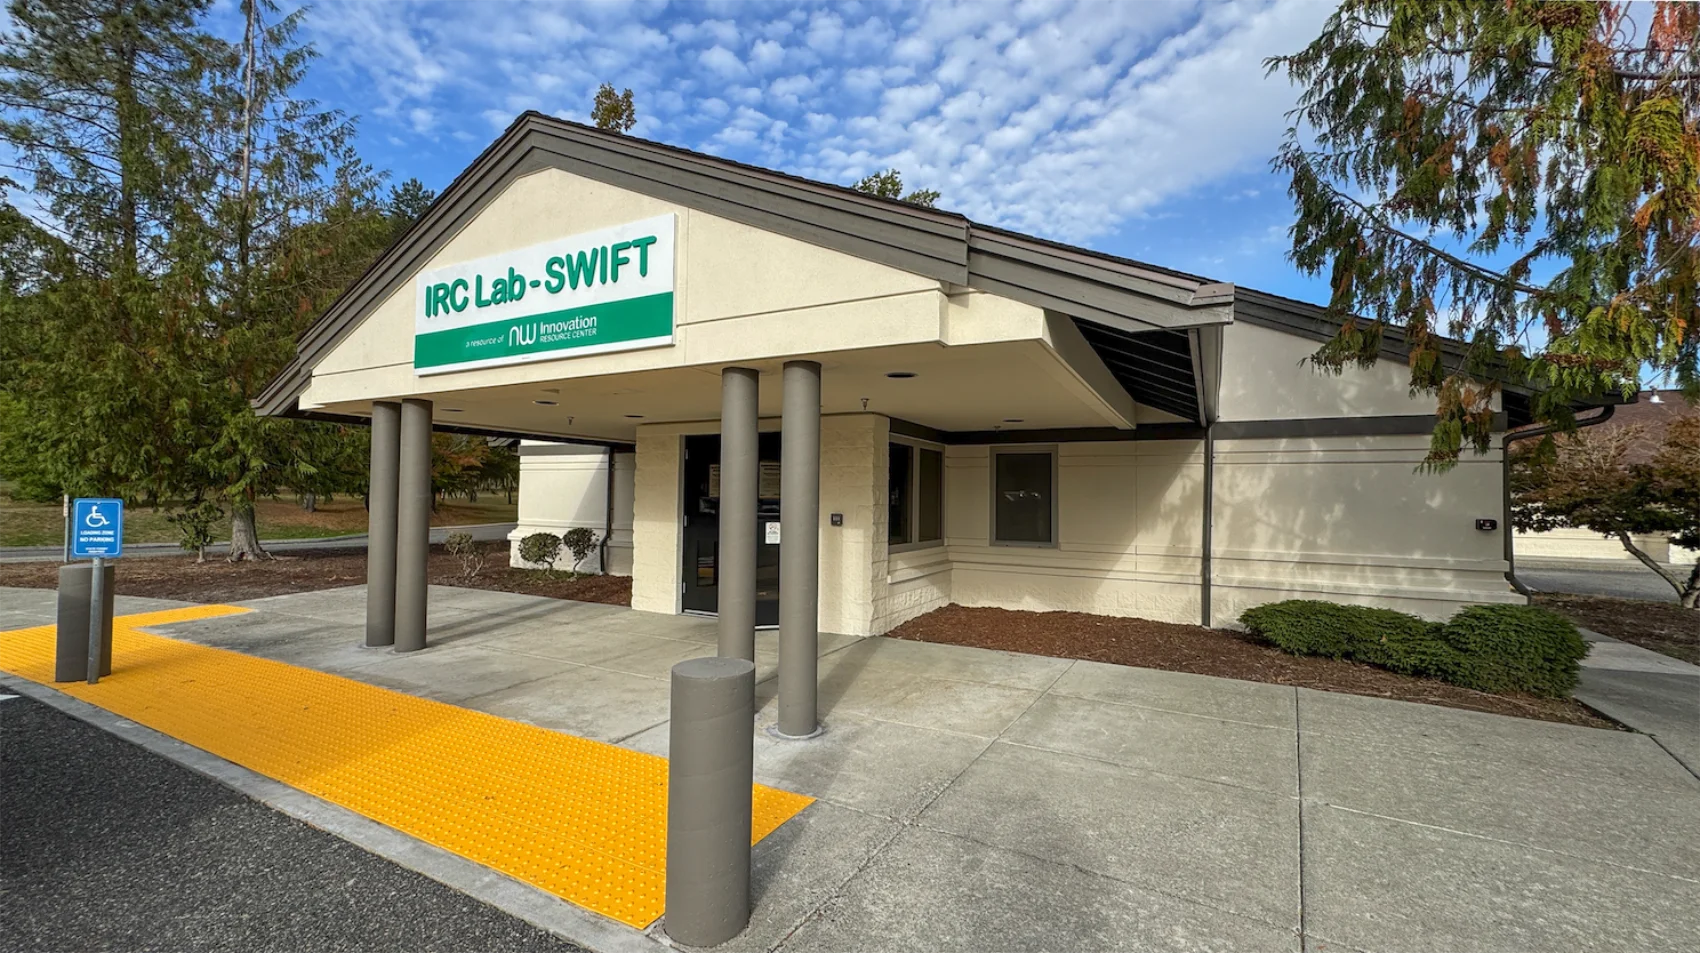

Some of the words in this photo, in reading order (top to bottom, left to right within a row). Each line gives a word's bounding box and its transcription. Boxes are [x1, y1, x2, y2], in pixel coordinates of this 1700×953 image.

[425, 278, 469, 318] IRC
[540, 315, 597, 334] Innovation
[471, 338, 497, 347] resource
[497, 335, 504, 343] of
[540, 331, 571, 343] RESOURCE
[572, 328, 597, 338] CENTER
